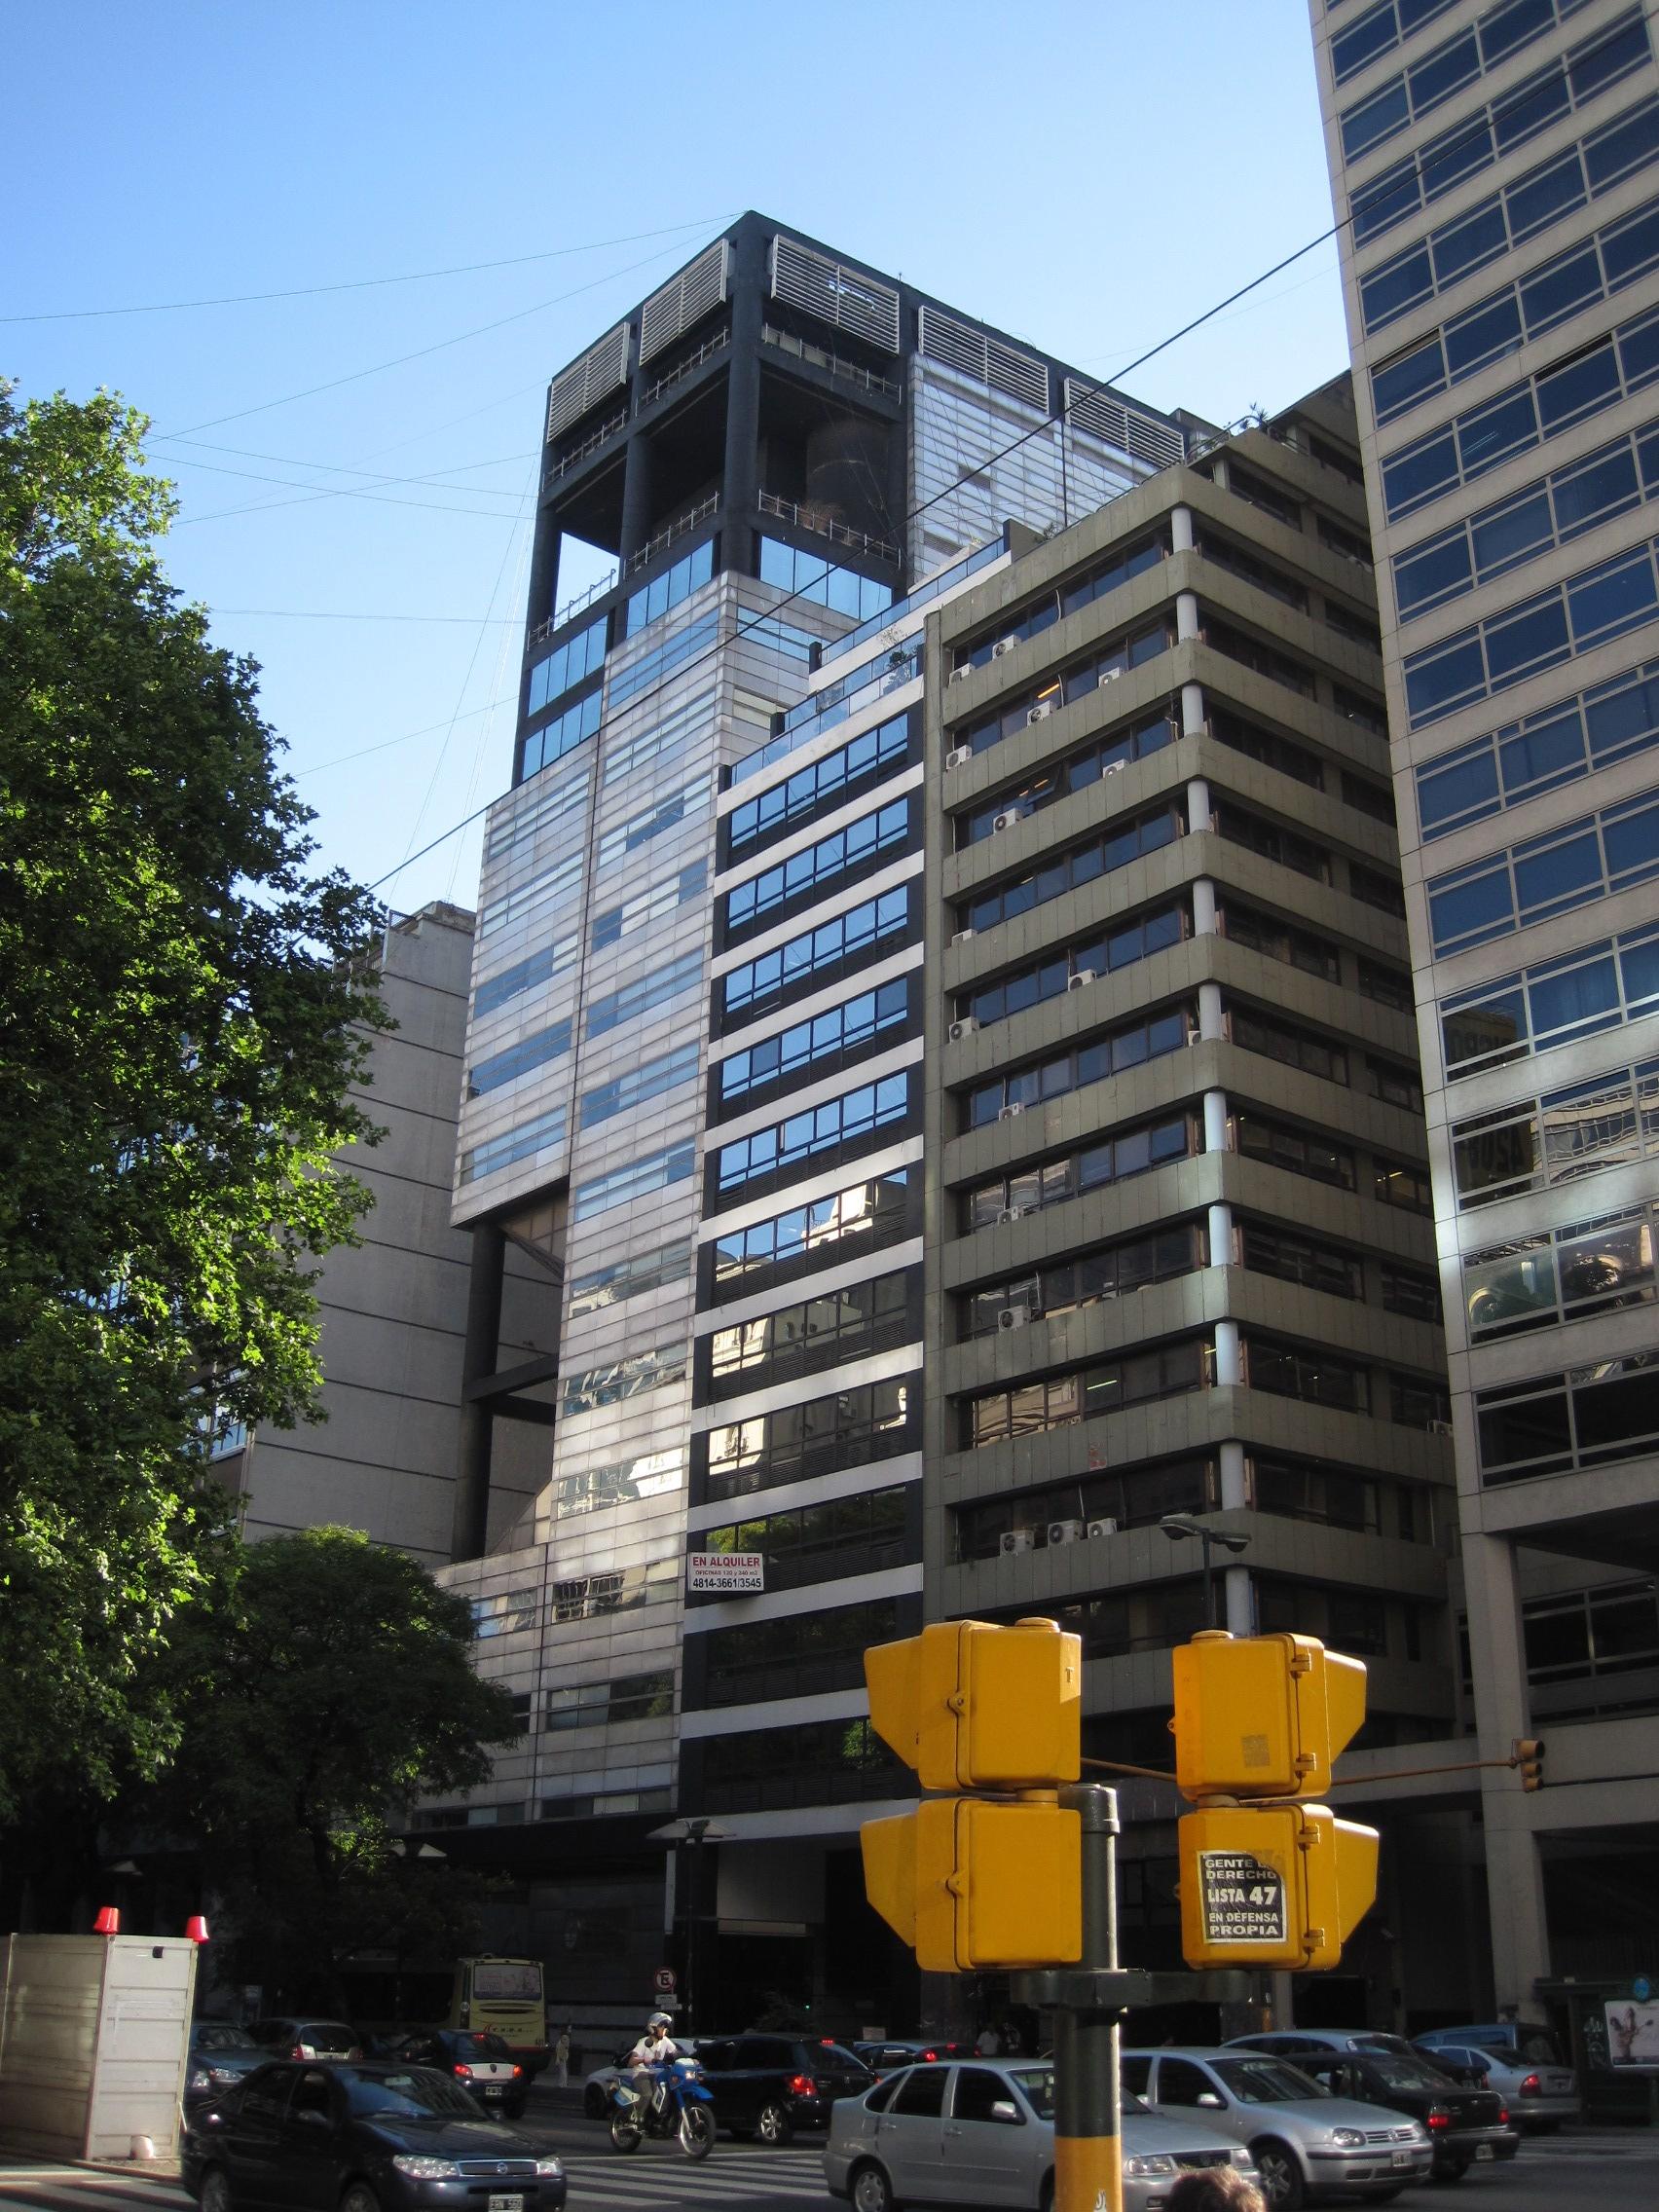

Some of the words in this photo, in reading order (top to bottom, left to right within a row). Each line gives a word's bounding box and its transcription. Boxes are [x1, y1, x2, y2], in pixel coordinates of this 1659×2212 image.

[692, 1557, 707, 1567] EN
[710, 1557, 760, 1567] ALQUILER
[1204, 1859, 1253, 1868] GENTE
[1207, 1888, 1245, 1902] LISTA
[1249, 1886, 1276, 1905] 47
[1209, 1912, 1223, 1923] EN
[1227, 1912, 1278, 1923] DEFENSA
[1209, 1925, 1278, 1936] PROPIA
